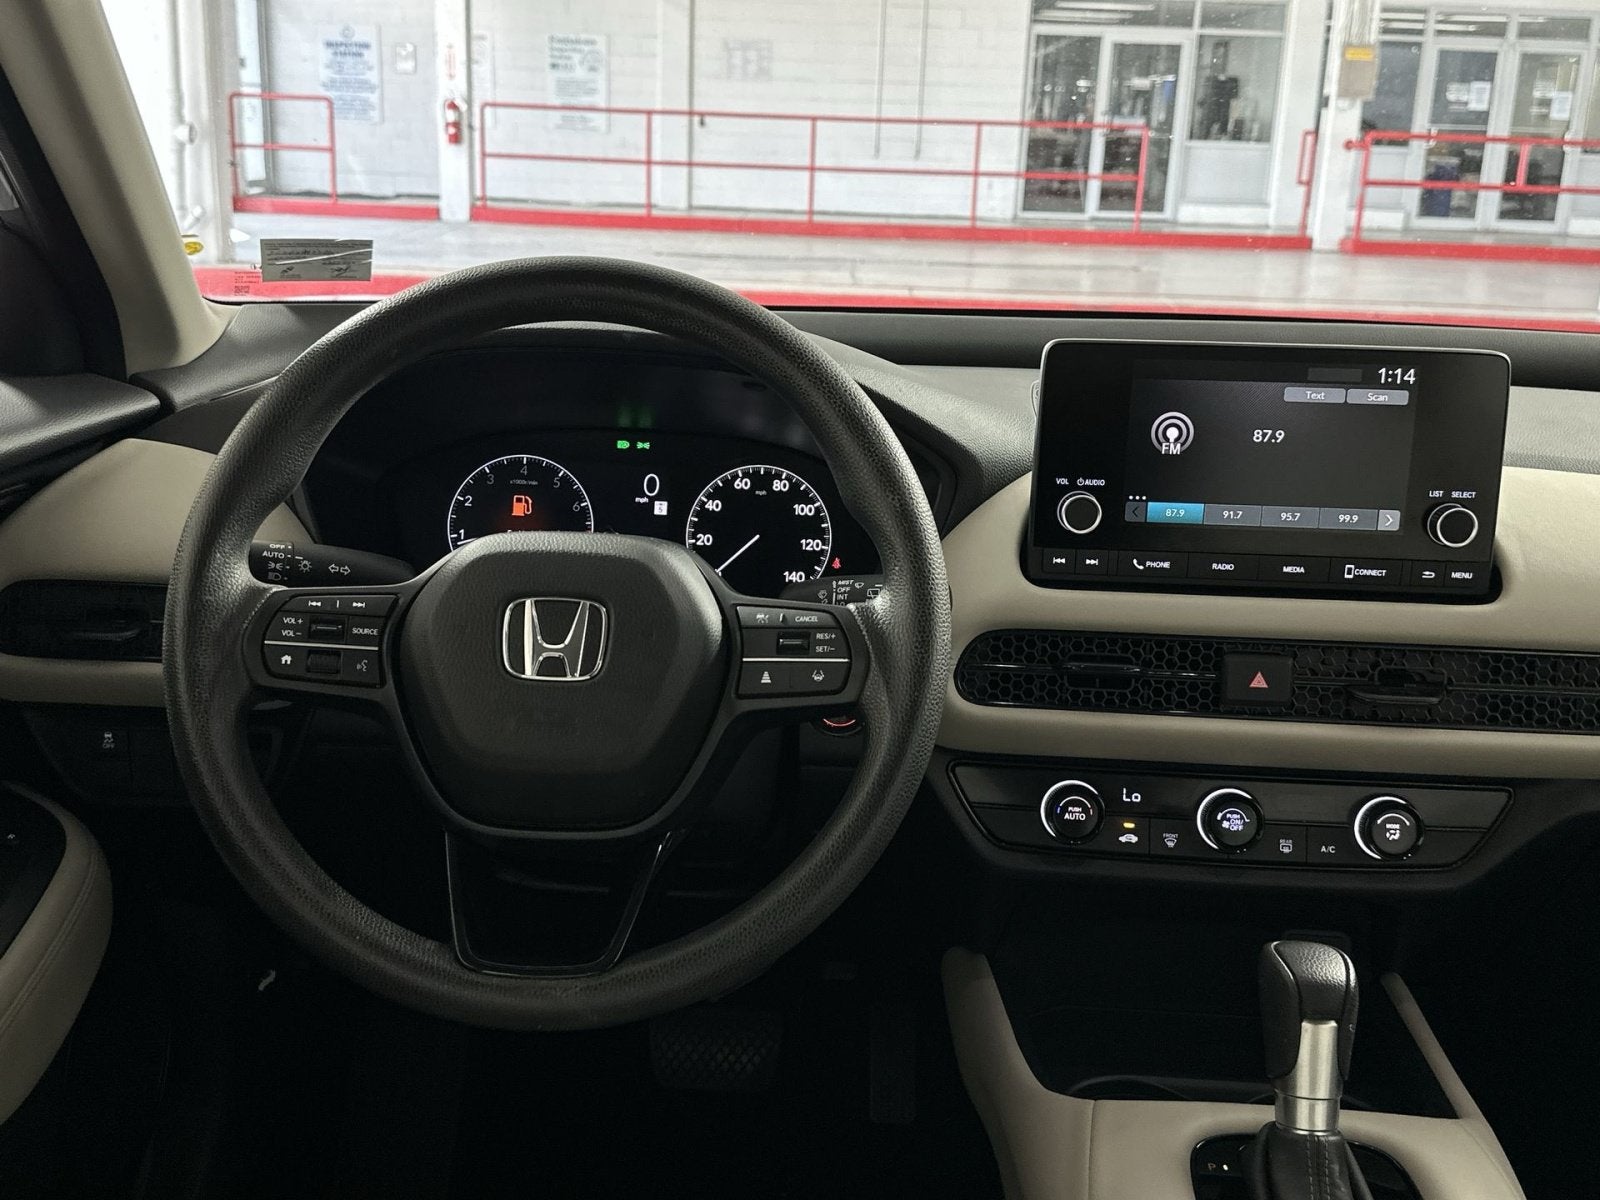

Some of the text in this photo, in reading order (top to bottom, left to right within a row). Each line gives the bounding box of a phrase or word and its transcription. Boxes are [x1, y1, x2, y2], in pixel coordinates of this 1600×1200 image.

[1378, 367, 1416, 385] 1:14
[1305, 391, 1325, 400] Text
[1367, 392, 1388, 402] Scan
[1252, 429, 1285, 443] 87.9
[1161, 442, 1181, 455] FM
[520, 465, 528, 476] 4
[486, 473, 495, 485] 3
[553, 477, 560, 488] 5
[643, 473, 660, 496] 0
[733, 478, 751, 490] 60
[1056, 477, 1069, 485] VOL
[772, 480, 789, 492] 80
[1428, 490, 1477, 499] LIST SELECT
[464, 495, 473, 506] 2
[704, 500, 722, 512] 40
[572, 502, 580, 512] 6
[793, 504, 815, 516] 100
[1165, 508, 1185, 517] 87.9
[1222, 510, 1243, 519] 91.7
[1280, 512, 1301, 521] 95.7
[1338, 514, 1359, 524] 99.9
[459, 528, 465, 540] 1
[696, 533, 713, 546] 20
[800, 539, 822, 551] 120
[262, 550, 285, 559] AUTO
[1145, 561, 1171, 569] PHONE
[1212, 563, 1235, 571] RADIO
[783, 571, 805, 583] 140
[1354, 568, 1387, 577] CONNECT
[352, 628, 379, 636] SOURCE
[1320, 845, 1336, 853] A/C
